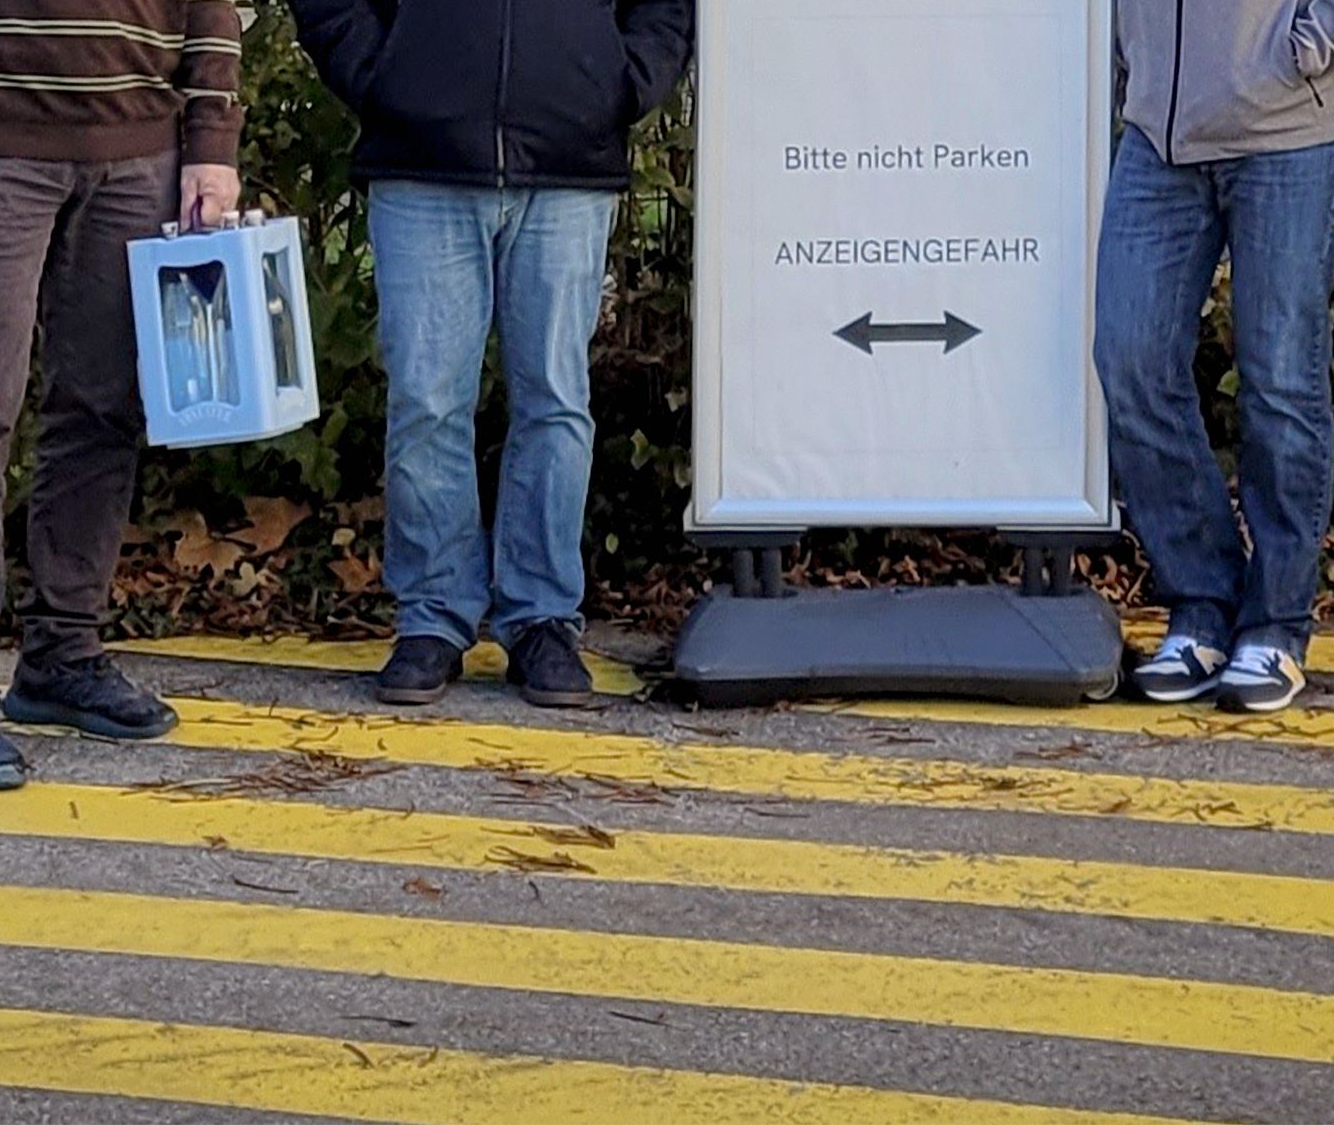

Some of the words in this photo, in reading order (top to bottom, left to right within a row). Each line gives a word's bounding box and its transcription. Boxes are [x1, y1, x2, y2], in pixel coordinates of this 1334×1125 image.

[784, 146, 848, 170] Bitte
[856, 145, 924, 169] nicht
[933, 144, 1030, 168] Parken
[774, 238, 1040, 265] ANZEIGENGEFAHR
